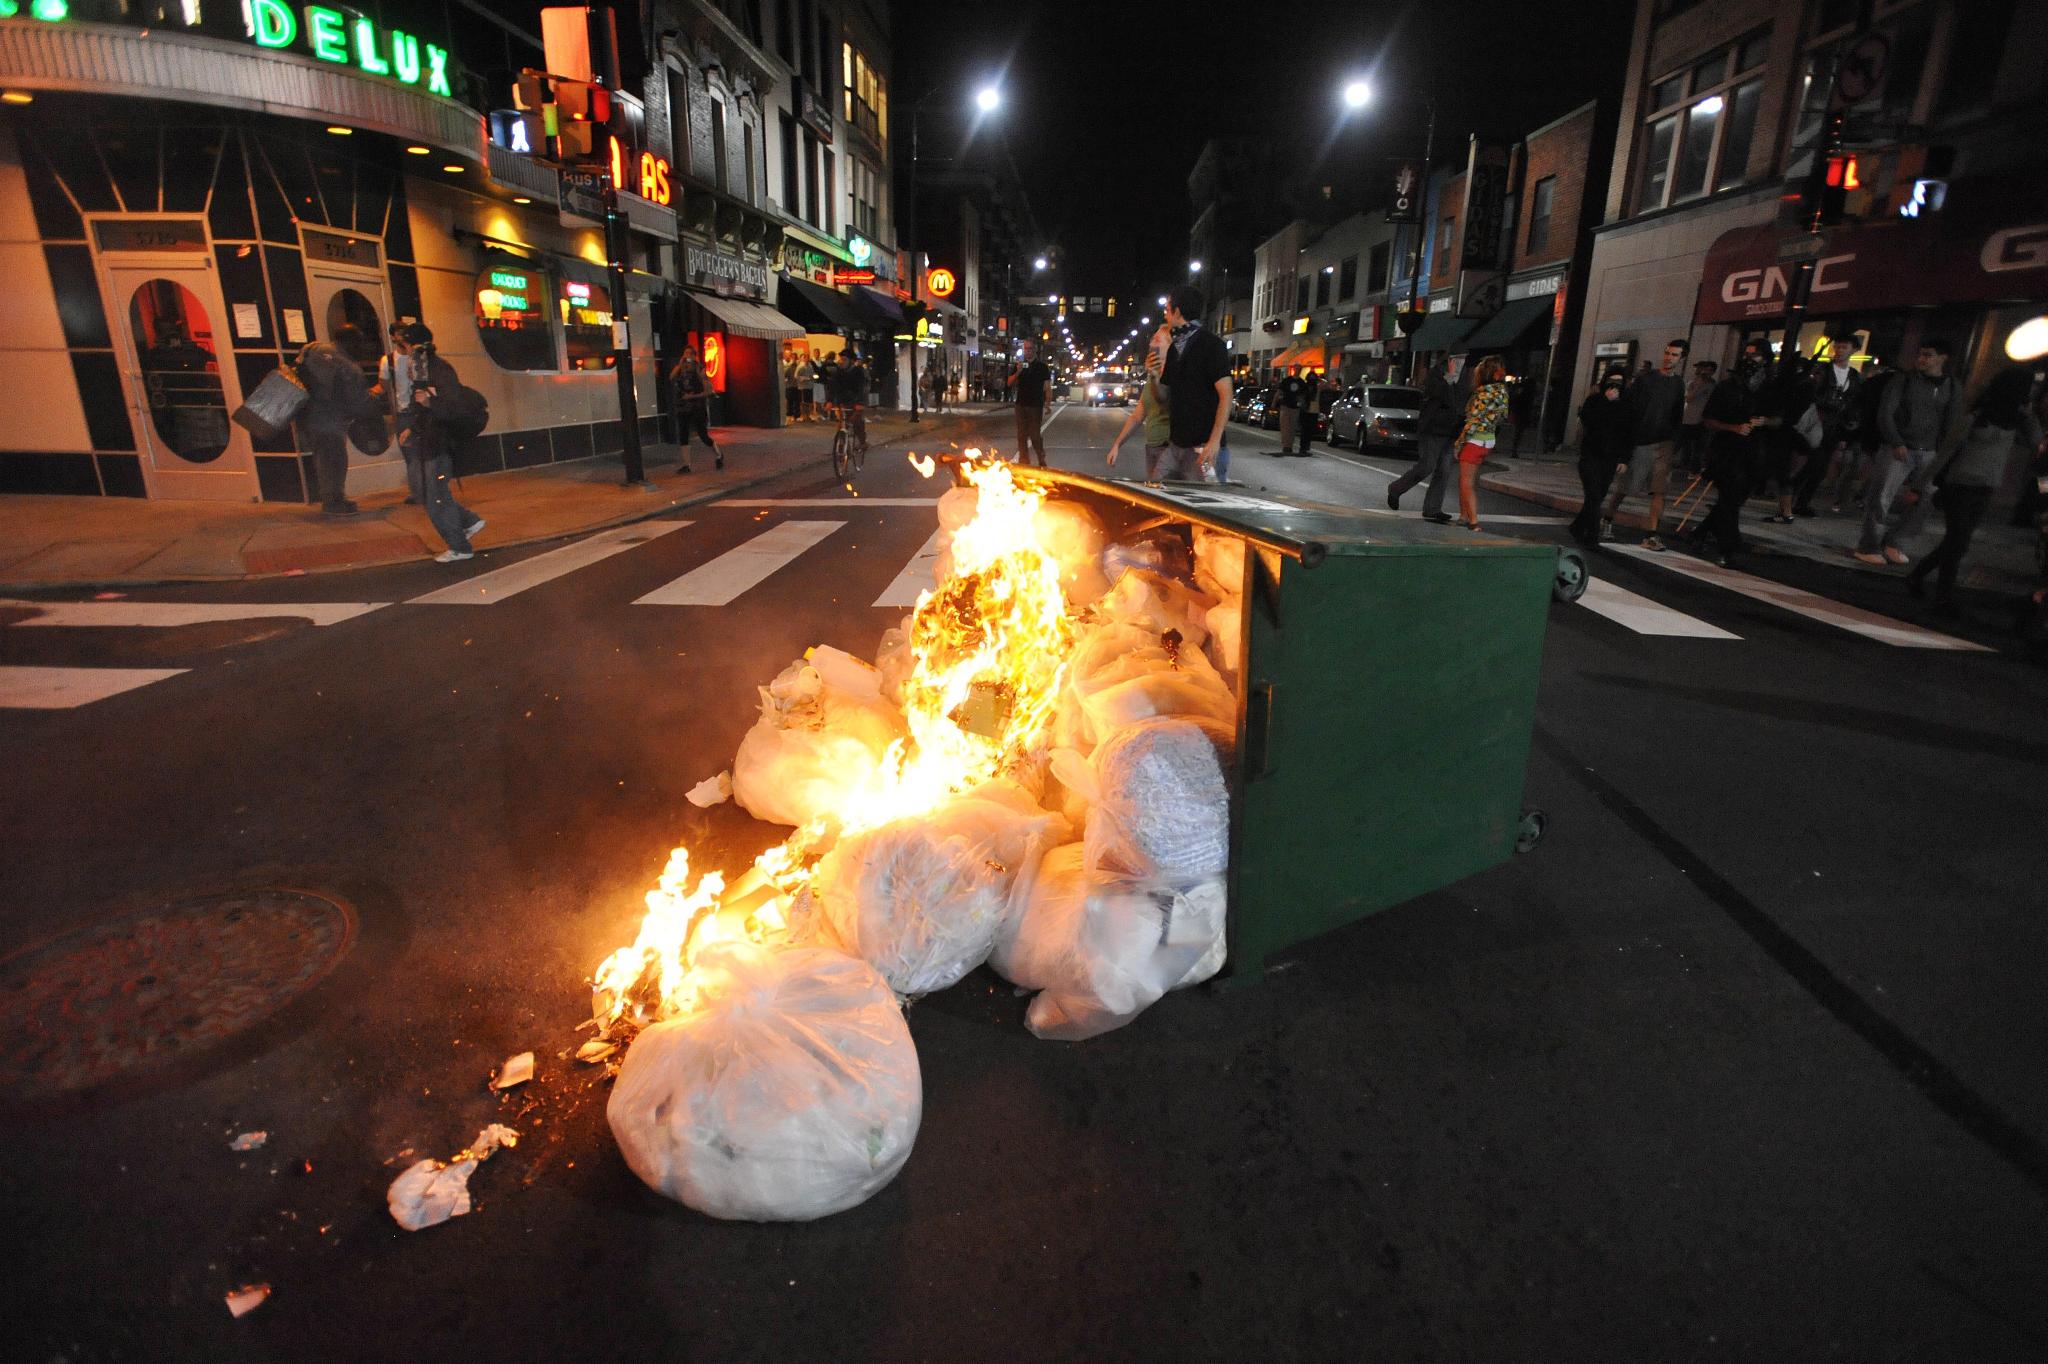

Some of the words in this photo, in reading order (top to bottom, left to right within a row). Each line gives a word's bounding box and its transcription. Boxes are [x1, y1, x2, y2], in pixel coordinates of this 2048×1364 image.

[254, 0, 451, 97] DELUX
[687, 247, 740, 281] BRUEGGER'S
[740, 263, 767, 292] BAGELS
[1529, 274, 1559, 296] GIDAS
[1721, 252, 1857, 303] GNC
